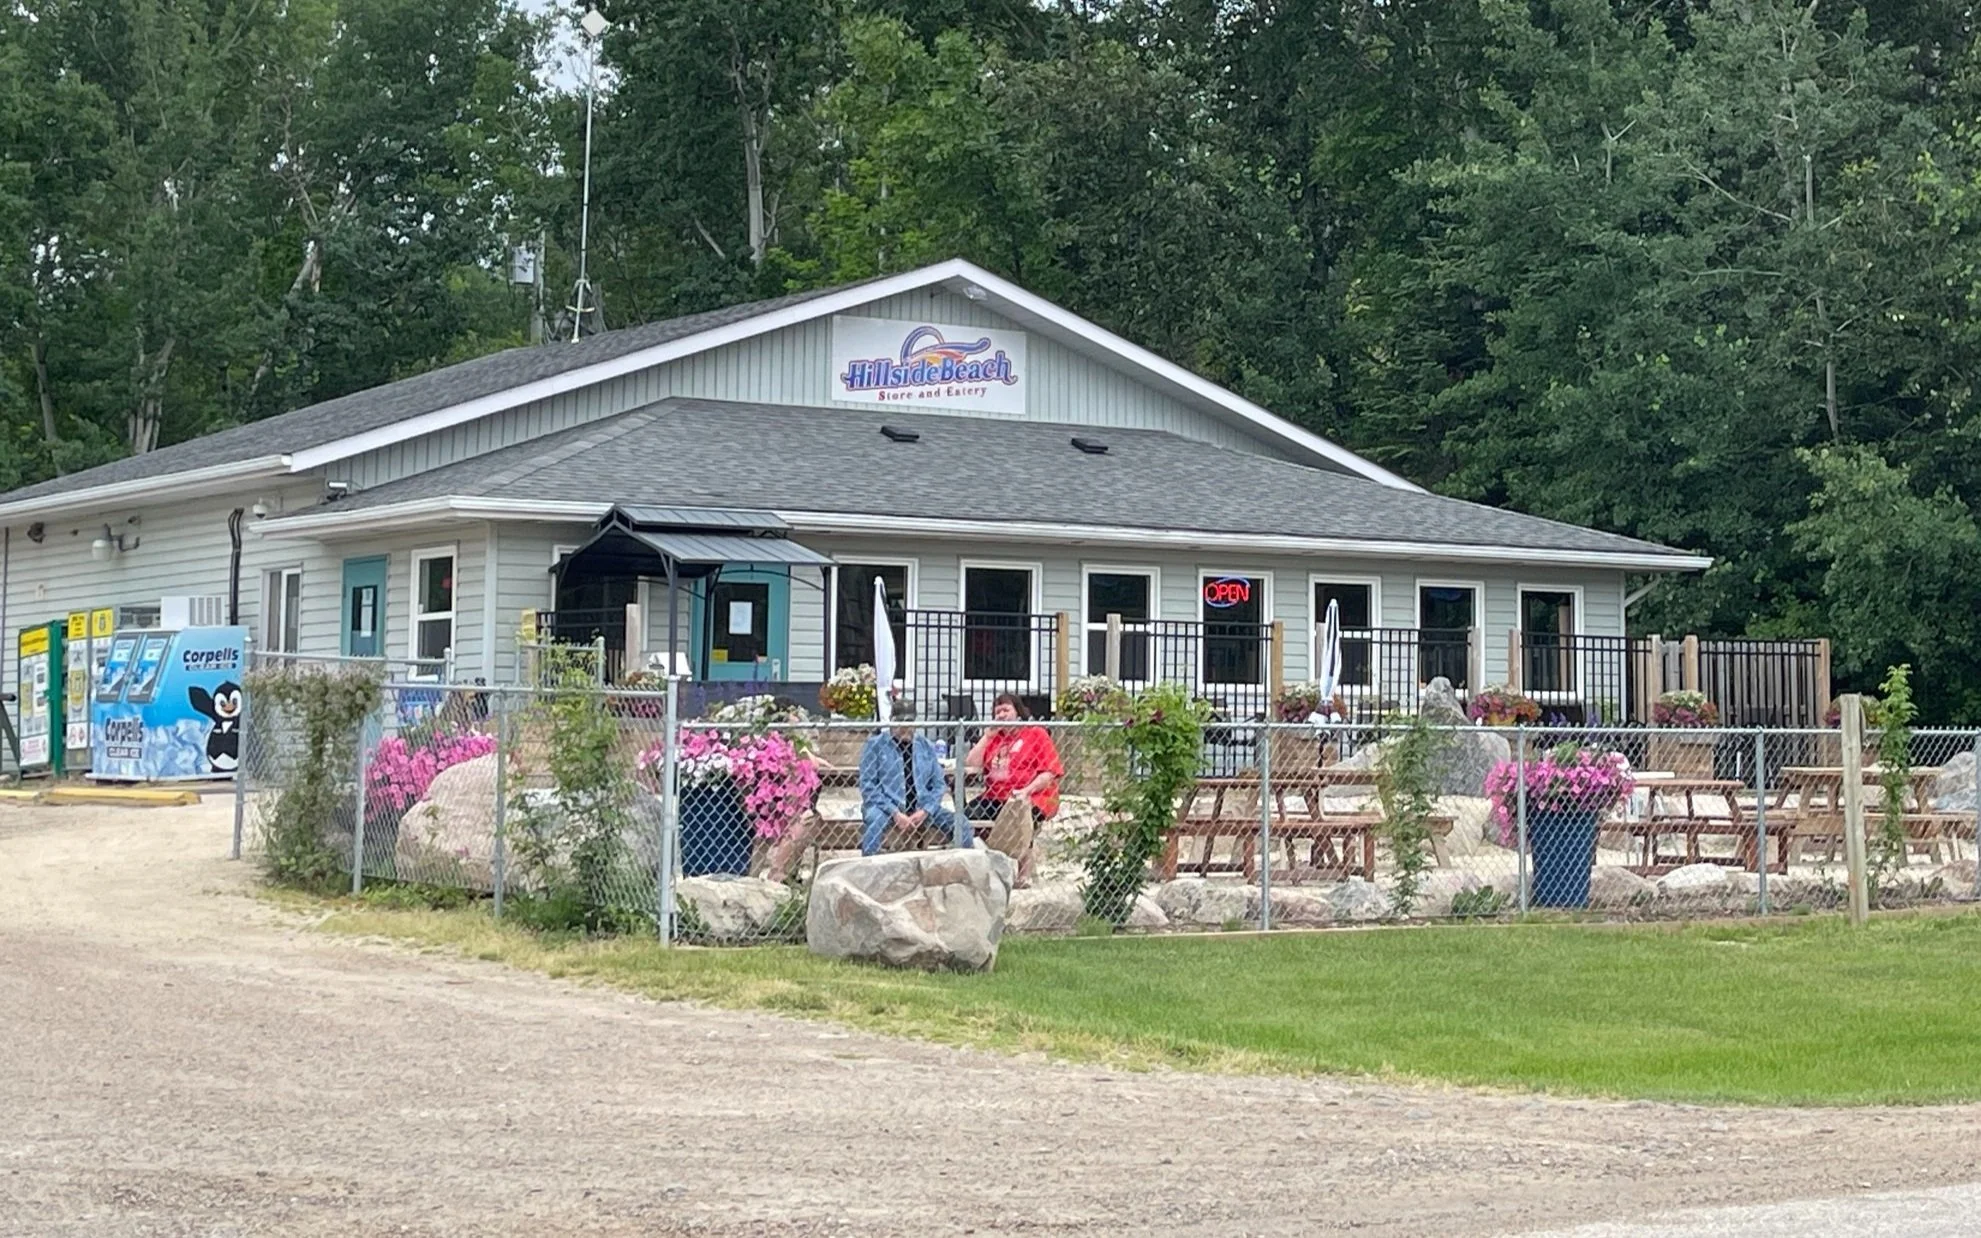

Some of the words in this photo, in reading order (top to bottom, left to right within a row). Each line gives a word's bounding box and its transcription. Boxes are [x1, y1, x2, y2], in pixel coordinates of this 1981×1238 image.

[878, 390, 913, 401] Store
[918, 387, 941, 399] and
[946, 386, 988, 398] Eatery
[1205, 583, 1249, 602] OPEN
[183, 647, 239, 663] Corpells
[105, 717, 143, 745] Corpells
